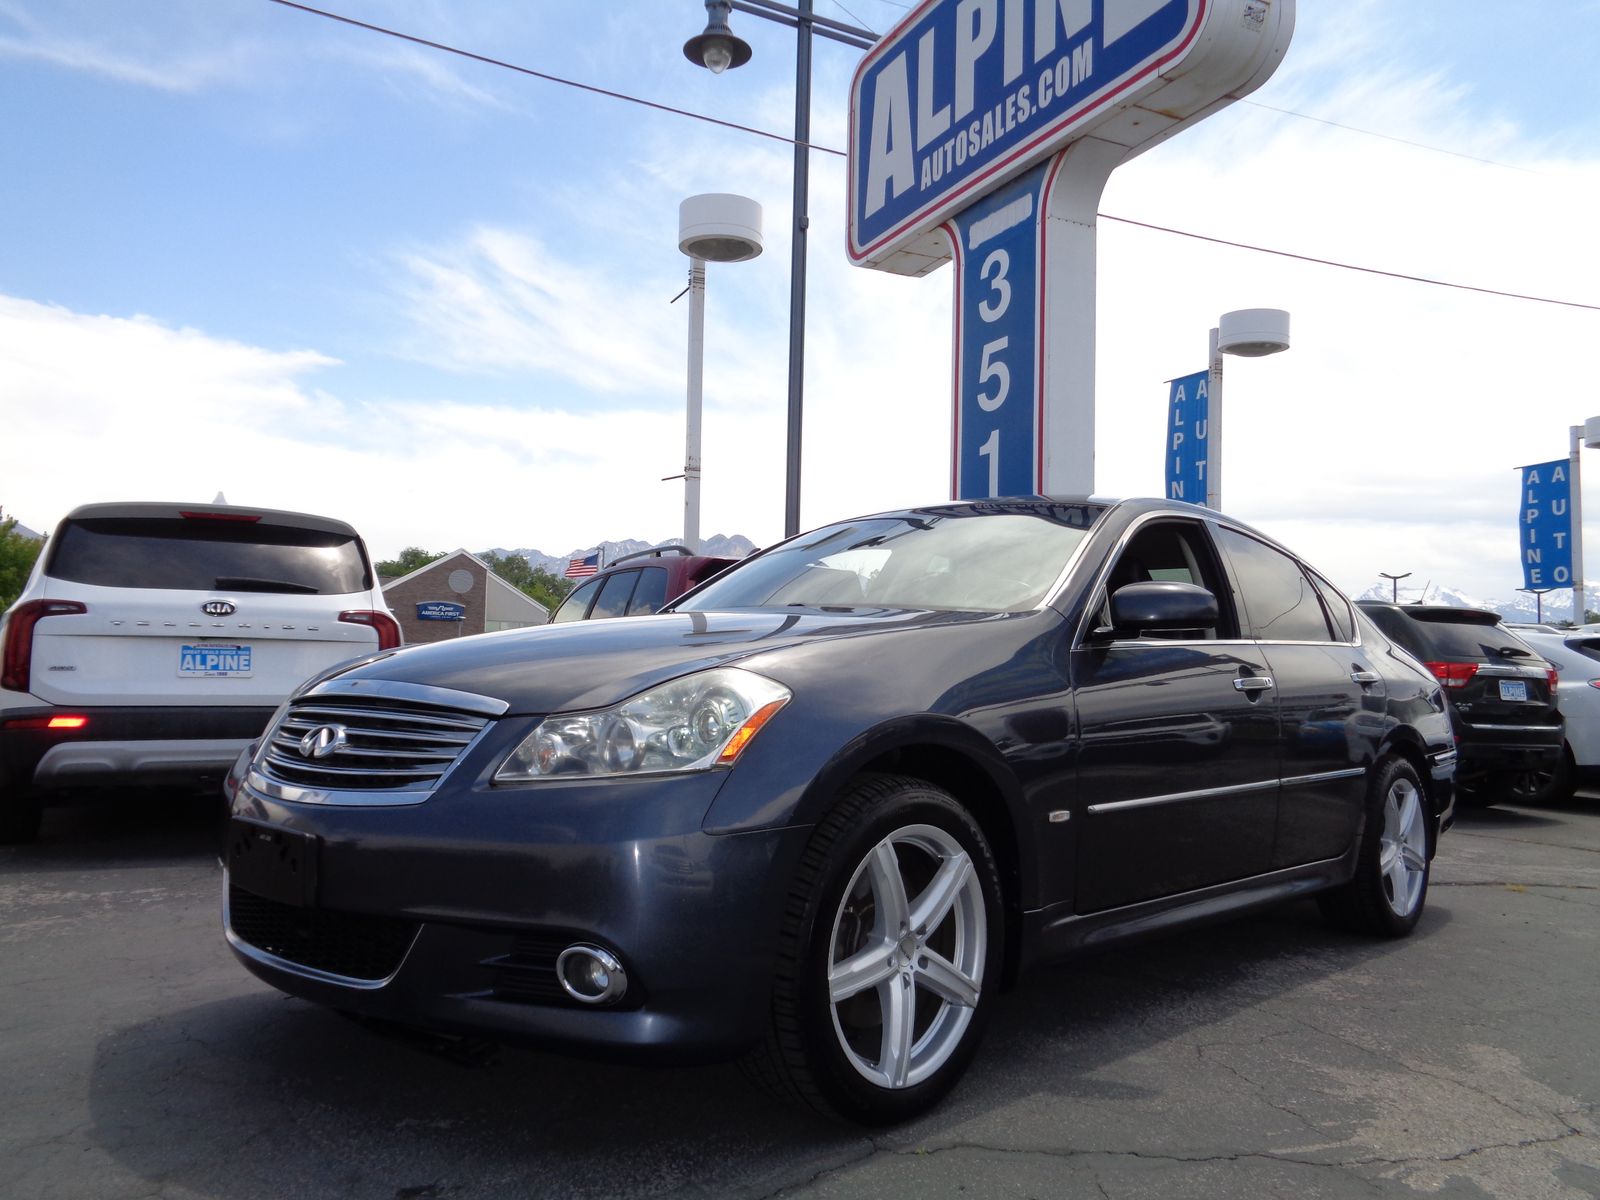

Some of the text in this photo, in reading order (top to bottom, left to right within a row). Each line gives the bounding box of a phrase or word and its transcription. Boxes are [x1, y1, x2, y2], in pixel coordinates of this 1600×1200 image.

[921, 37, 1093, 191] AUTOSALES.COM
[1195, 379, 1208, 508] AUT
[1526, 470, 1542, 584] ALPINE
[1551, 466, 1569, 583] AUTO
[182, 654, 250, 671] ALPINE
[206, 603, 232, 613] KIA
